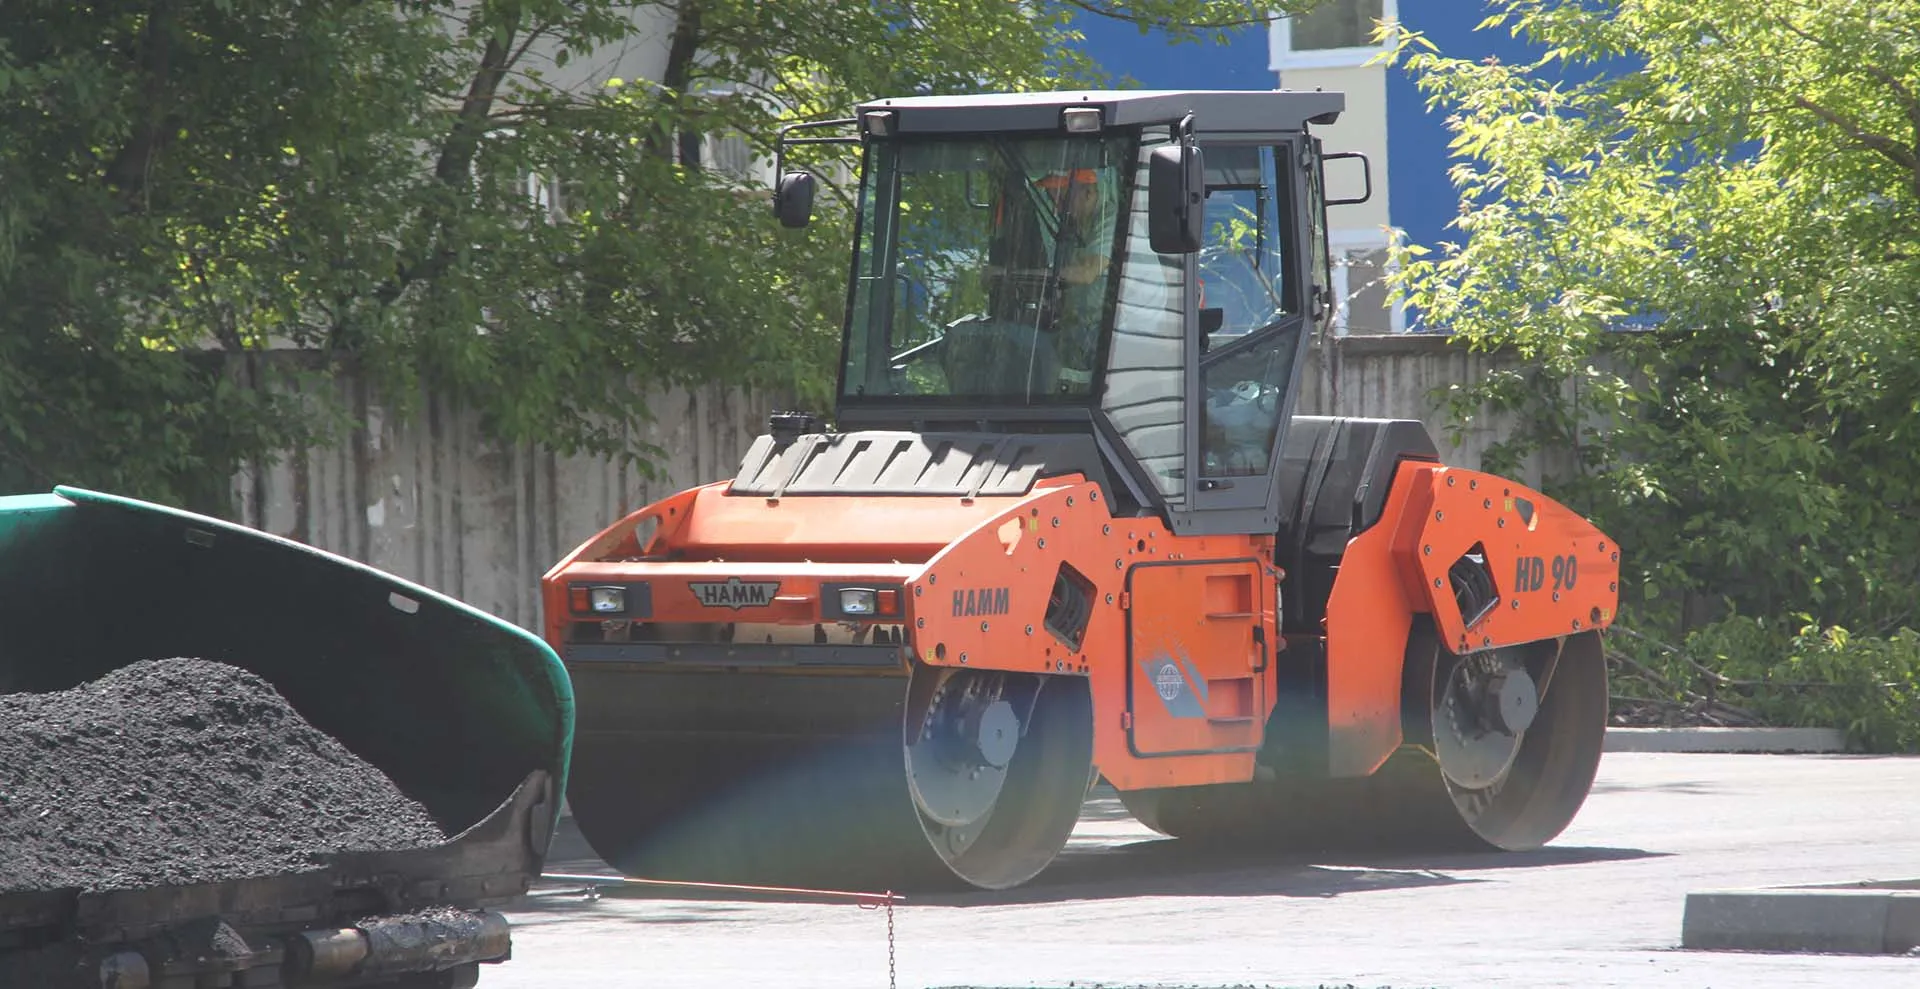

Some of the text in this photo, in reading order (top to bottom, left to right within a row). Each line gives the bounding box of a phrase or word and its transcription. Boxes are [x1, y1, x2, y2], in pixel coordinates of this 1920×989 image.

[1514, 554, 1578, 593] HD 90
[704, 585, 766, 603] HAMM
[952, 587, 1009, 617] HAMM
